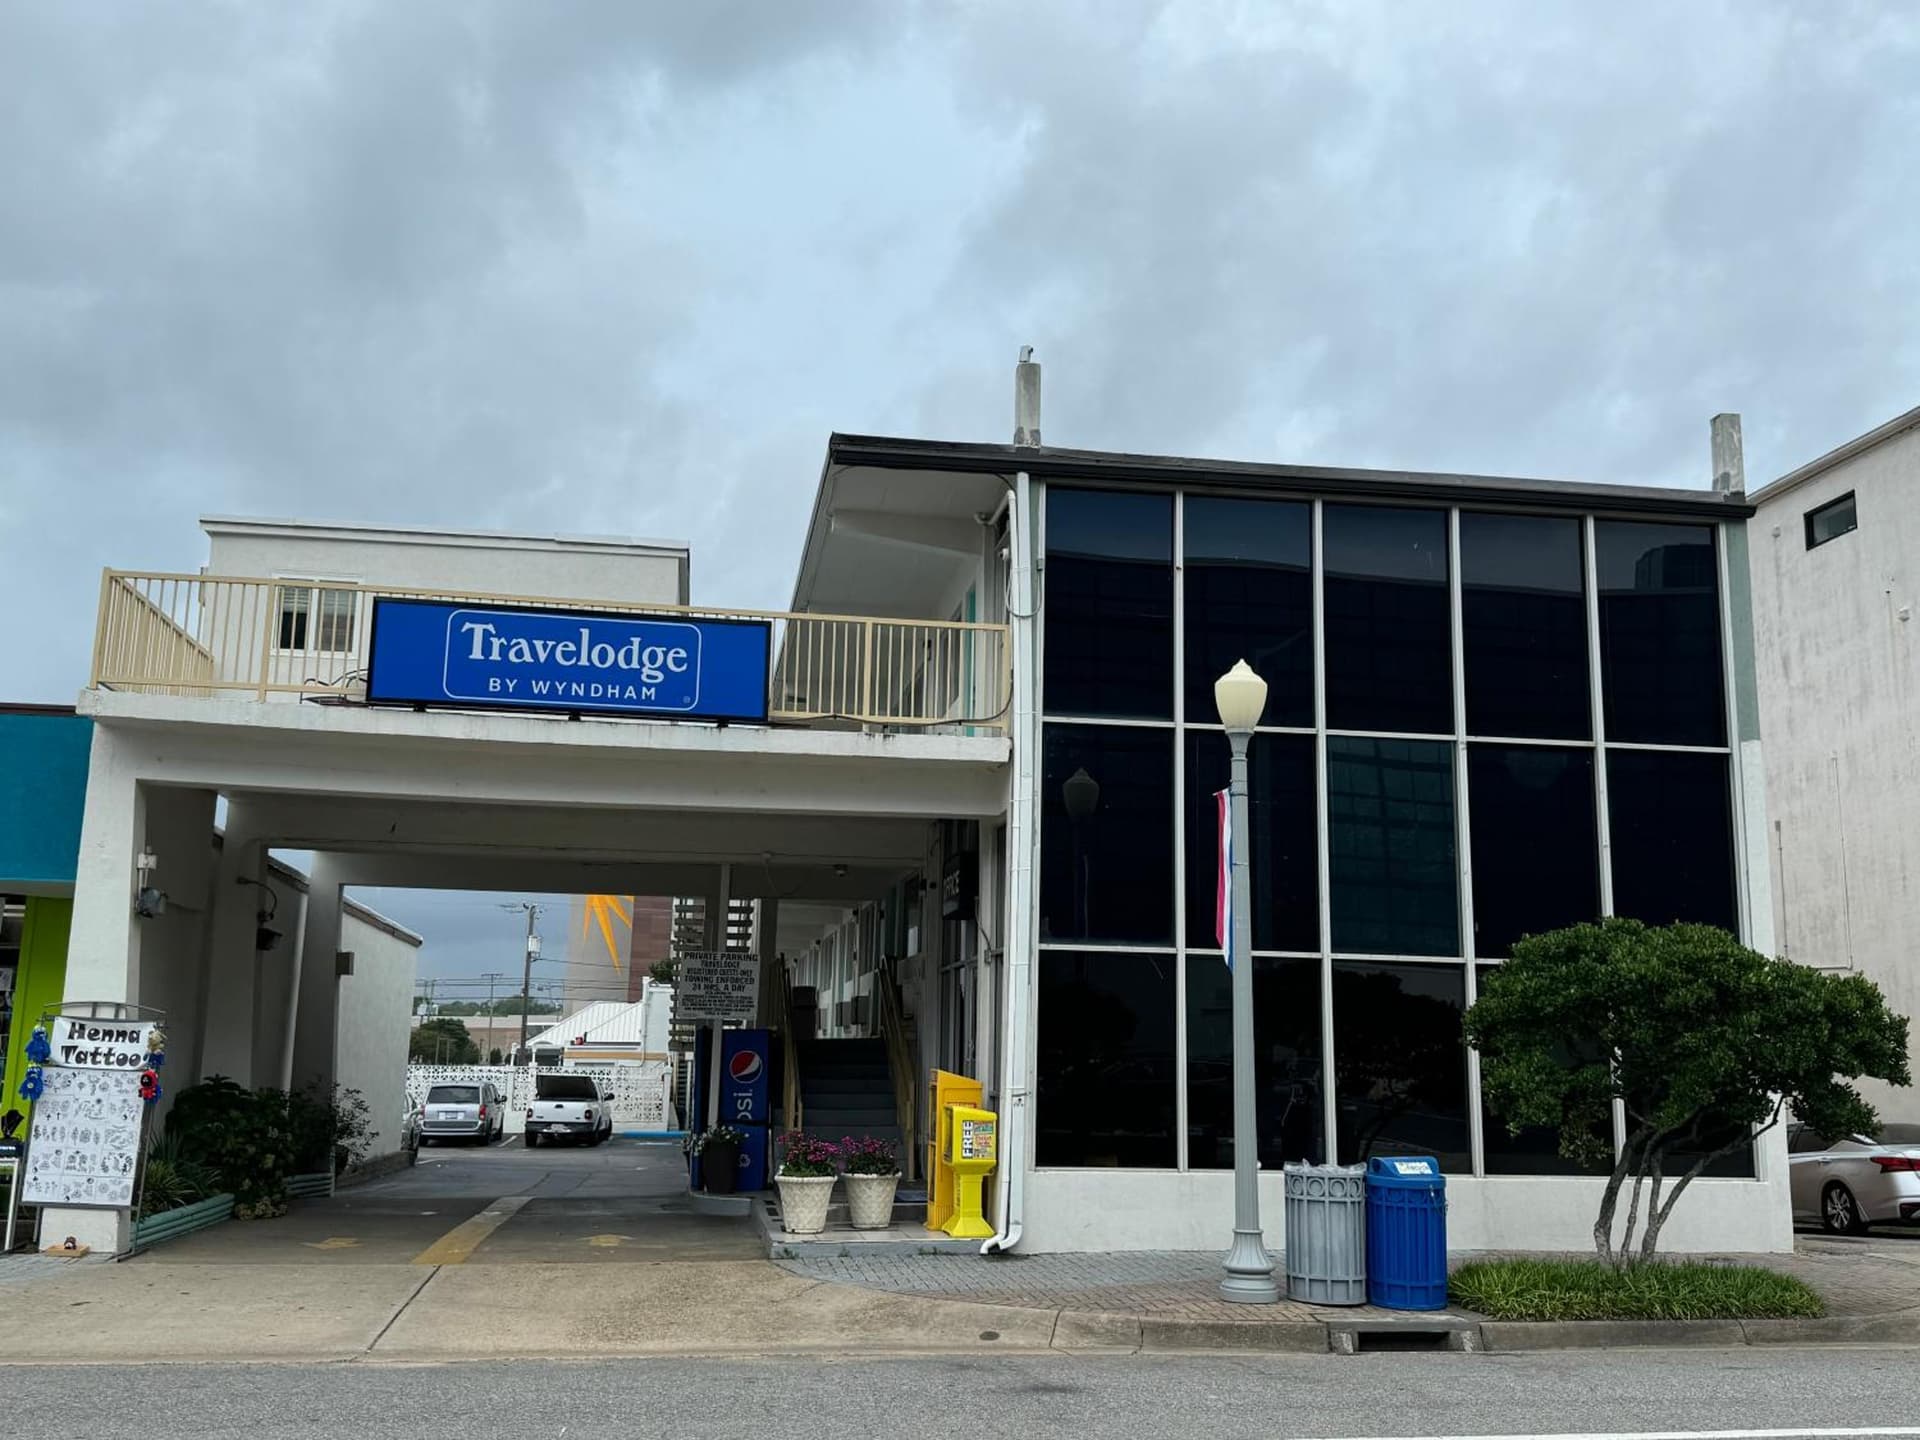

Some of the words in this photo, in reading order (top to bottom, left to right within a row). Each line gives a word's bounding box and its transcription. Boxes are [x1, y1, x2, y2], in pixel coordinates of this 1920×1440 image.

[460, 622, 687, 683] Travelodge
[488, 677, 518, 693] BY
[531, 680, 656, 701] WYNDHAM
[684, 952, 718, 960] PRIVATE
[721, 953, 758, 961] PARKING
[684, 975, 713, 983] TOWING
[716, 976, 755, 984] ENFORCED
[731, 984, 746, 992] DAY
[67, 1021, 141, 1043] Henna
[60, 1045, 141, 1067] Tattoo
[963, 1120, 973, 1158] FREE
